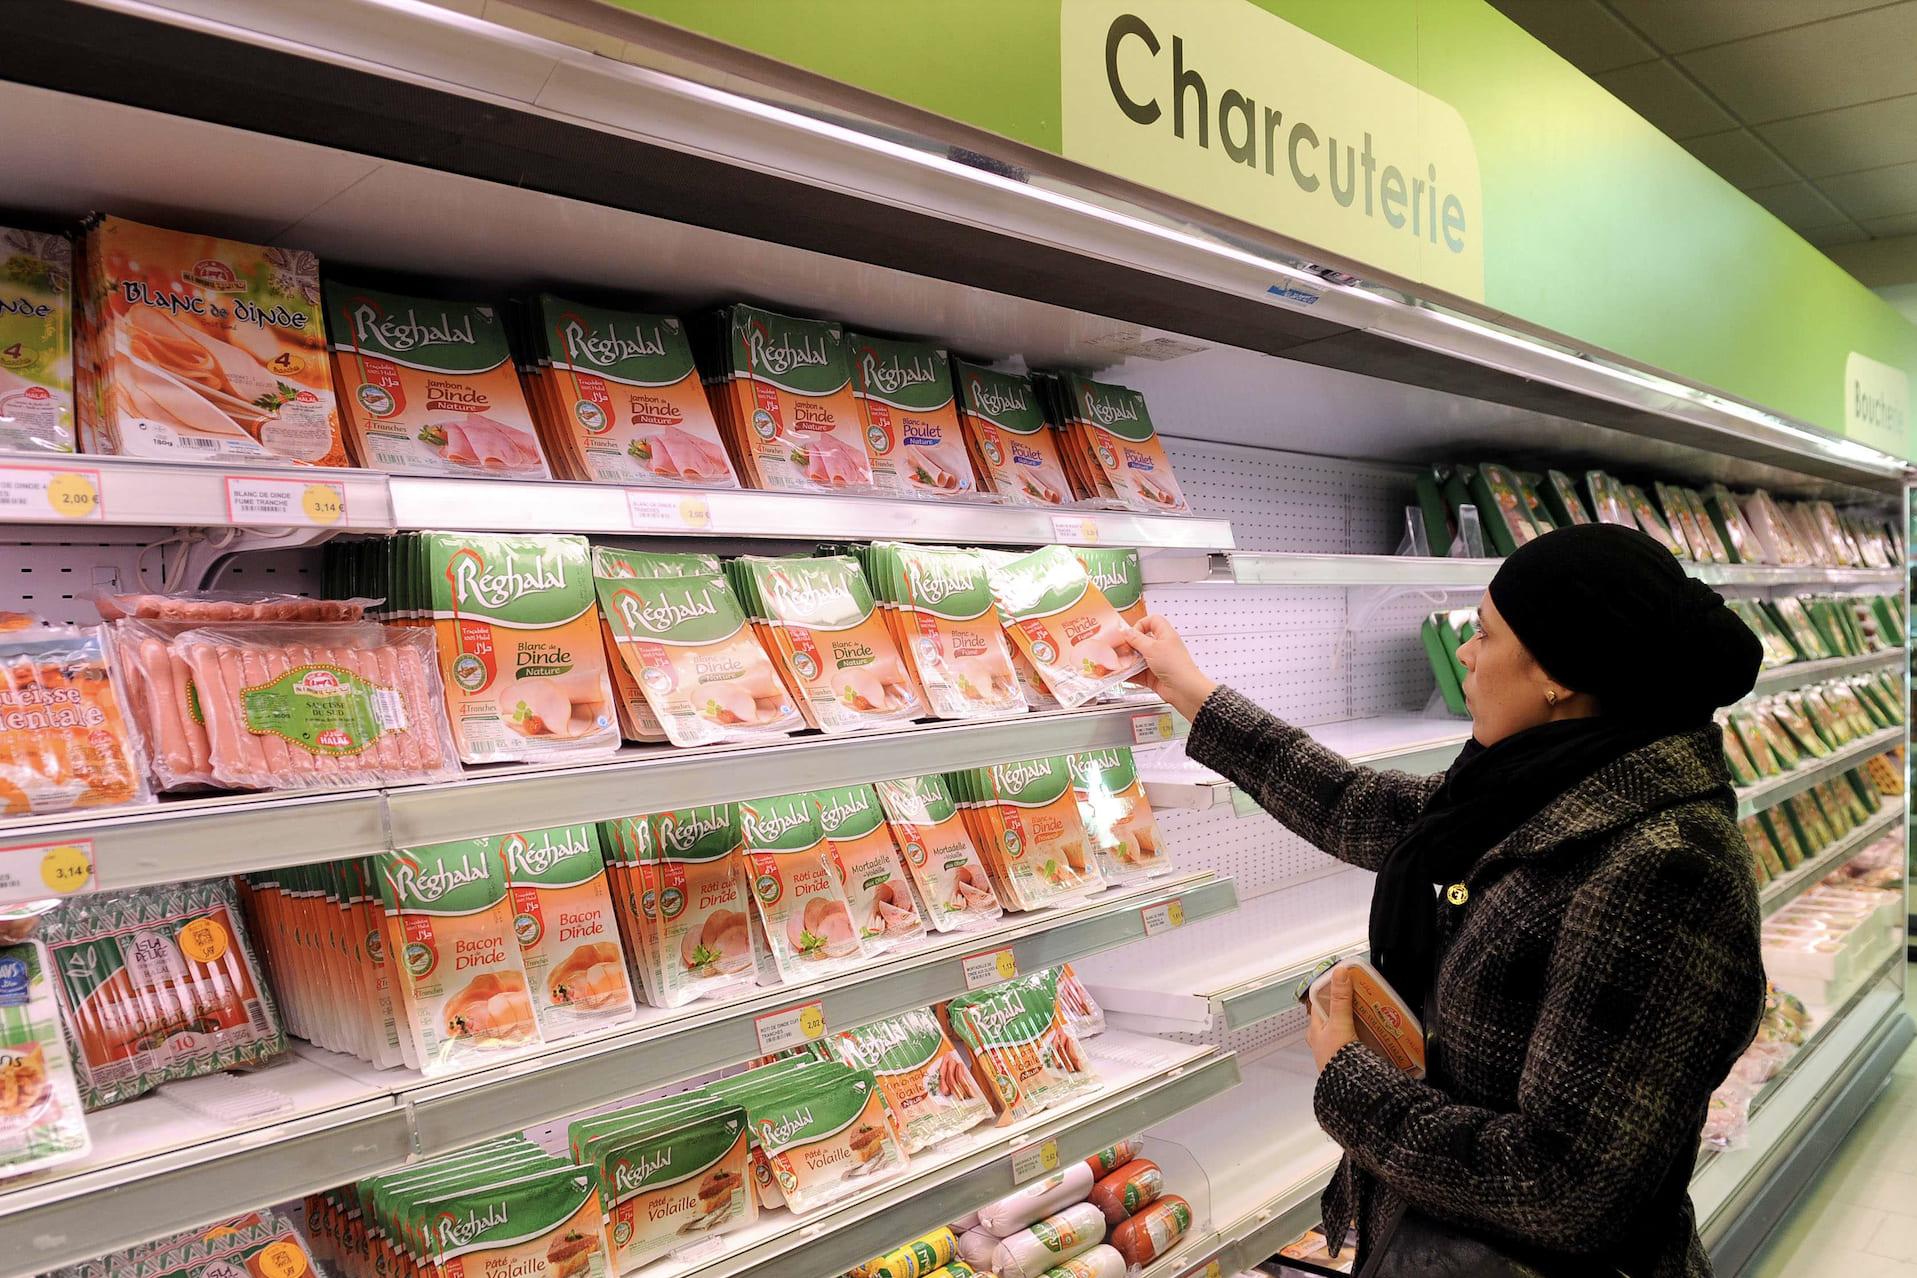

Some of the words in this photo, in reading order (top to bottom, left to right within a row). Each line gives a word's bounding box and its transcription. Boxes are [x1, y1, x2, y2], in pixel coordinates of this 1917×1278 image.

[1105, 13, 1466, 254] Charcuterie
[354, 303, 476, 351] Réghalal
[4, 342, 22, 359] 4
[567, 320, 667, 366] Réghalal
[275, 352, 291, 368] 4
[750, 329, 829, 375] Réghalal
[863, 353, 936, 394] Réghalal
[427, 387, 489, 404] Dinde
[972, 379, 1027, 416] Réghalal
[437, 401, 477, 412] Nature
[632, 403, 681, 417] Dinde
[1085, 391, 1138, 425] Réghalal
[640, 415, 673, 425] Nature
[795, 409, 835, 423] Dinde
[364, 420, 372, 431] 4
[373, 422, 407, 433] Tranches
[903, 424, 942, 438] Poulet
[583, 437, 589, 448] 4
[1012, 446, 1043, 461] Poulet
[1125, 451, 1155, 466] Poulet
[62, 493, 88, 504] 2,00
[234, 491, 258, 499] BLANC
[256, 499, 289, 507] TRANCHE
[314, 502, 336, 513] 3,14
[457, 554, 567, 609] Réghalal
[911, 569, 976, 605] Réghalal
[621, 589, 718, 633] Réghalal
[951, 630, 970, 638] Blanc
[1064, 616, 1098, 639] Dinde
[517, 642, 547, 651] Blanc
[832, 641, 852, 649] Blanc
[952, 635, 986, 648] Dinde
[517, 648, 572, 666] Dinde
[834, 643, 873, 660] Dinde
[695, 659, 743, 674] Dinde
[843, 657, 868, 667] Nature
[525, 666, 561, 677] Nature
[460, 703, 466, 714] 4
[466, 704, 497, 713] Tranches
[319, 736, 350, 746] HALAL
[661, 803, 730, 851] Réghalal
[743, 800, 811, 843] Réghalal
[1032, 817, 1064, 835] Dinde
[508, 826, 590, 876] Réghalal
[933, 842, 968, 856] Mortadelle
[851, 855, 891, 874] Mortadelle
[56, 867, 82, 879] 3,14
[396, 851, 490, 902] Réghalal
[793, 869, 811, 883] Rôti
[701, 884, 719, 895] Rôti
[794, 879, 830, 898] Dinde
[700, 889, 737, 910] Dinde
[560, 910, 601, 926] Bacon
[560, 921, 604, 942] Dinde
[135, 937, 161, 952] ISLA
[455, 936, 504, 954] Bacon
[456, 949, 506, 971] Dinde
[175, 1035, 196, 1051] 10
[762, 1107, 814, 1146] Réghalal
[804, 1149, 822, 1161] Pâté
[807, 1147, 851, 1171] Volaille
[615, 1146, 673, 1192] Réghalal
[648, 1196, 667, 1210] Pâté
[648, 1198, 697, 1224] Volaille
[439, 1200, 509, 1247] Réghalal
[485, 1257, 509, 1271] Pâté
